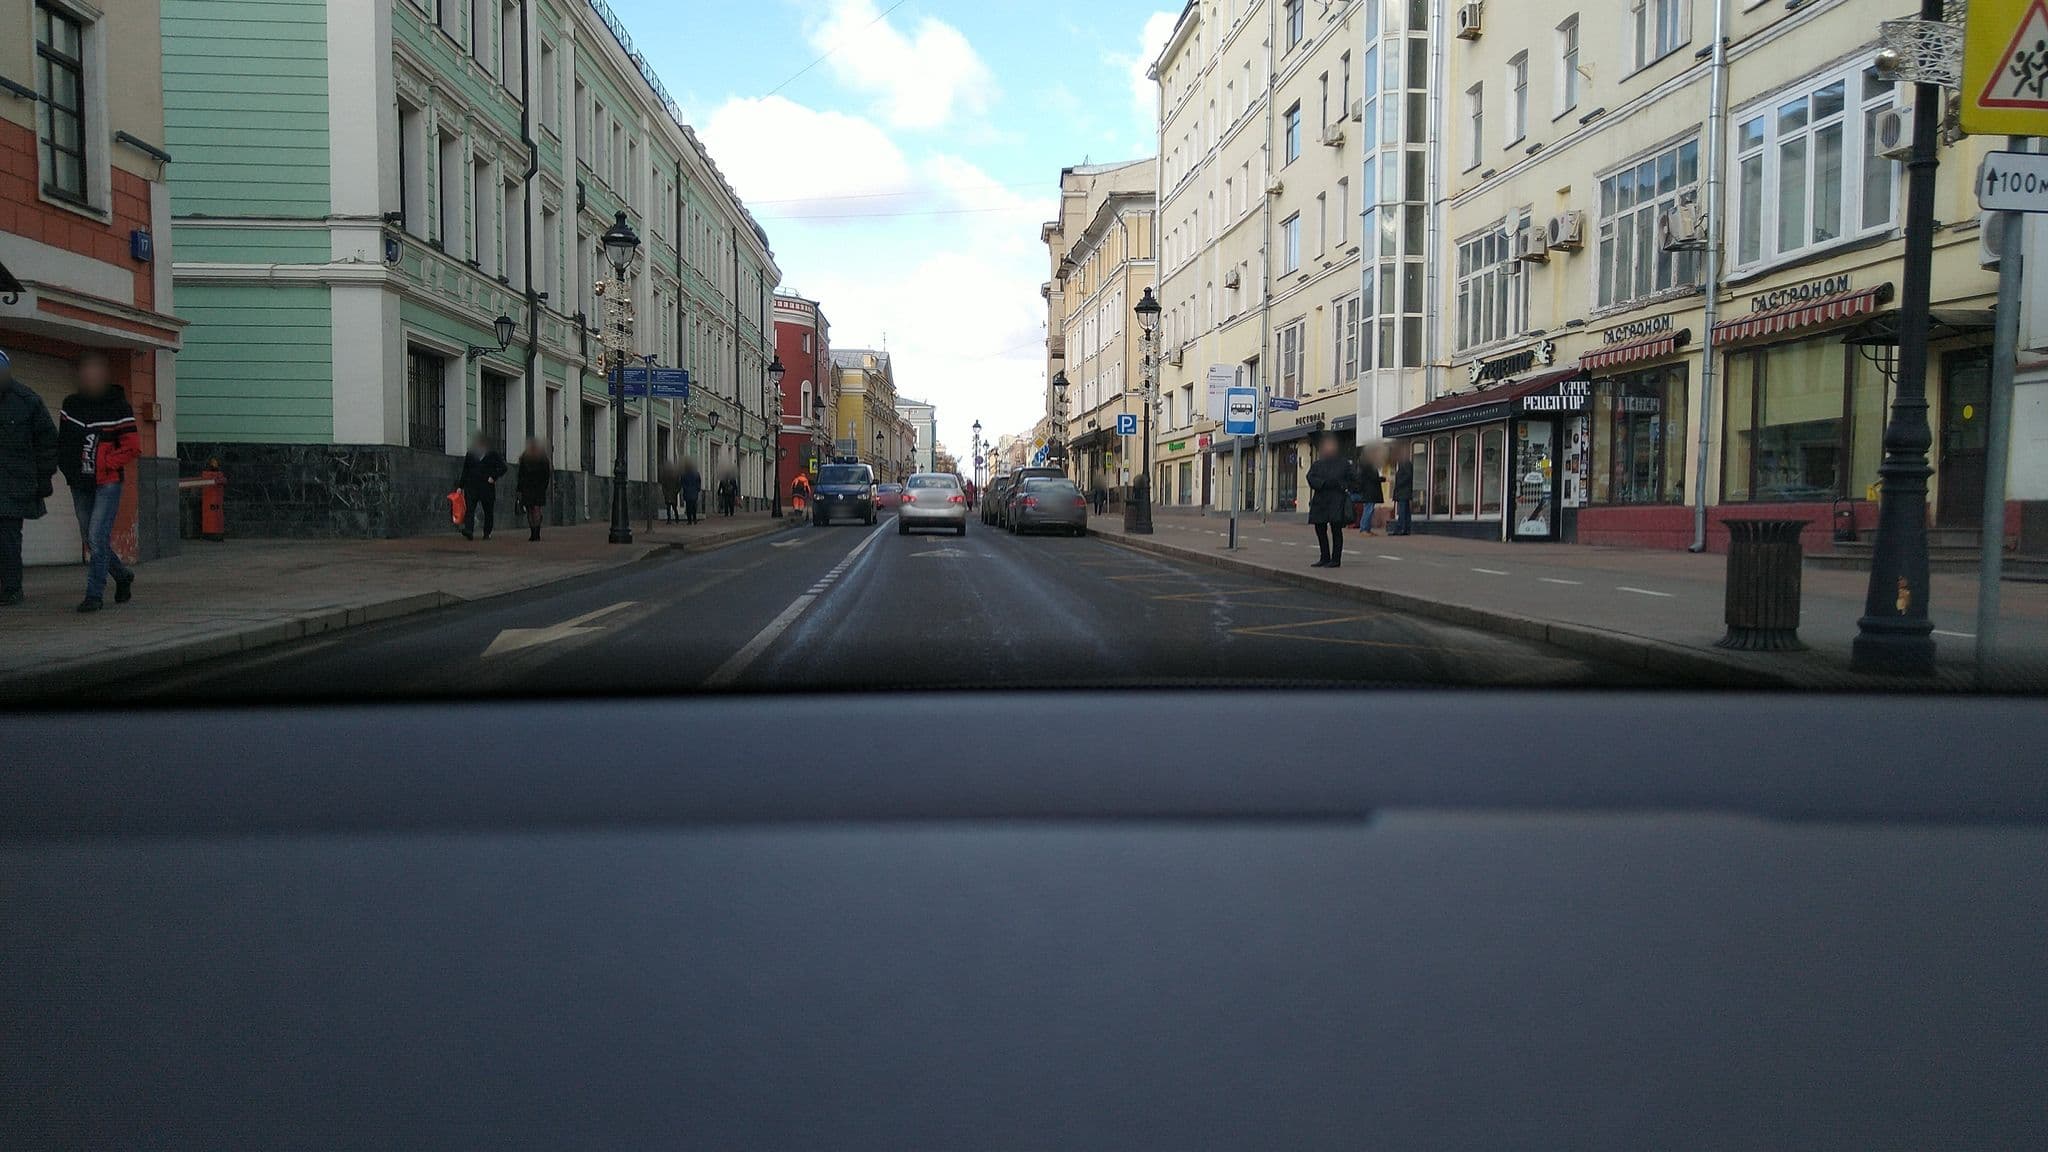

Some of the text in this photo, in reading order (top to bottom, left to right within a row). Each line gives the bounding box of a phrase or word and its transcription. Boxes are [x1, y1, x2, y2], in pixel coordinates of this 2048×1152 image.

[1751, 274, 1849, 312] ГАСТРОНОМ
[1603, 313, 1671, 343] ГАСТРОНОМ
[1523, 395, 1585, 411] РЕЦЕПТОР
